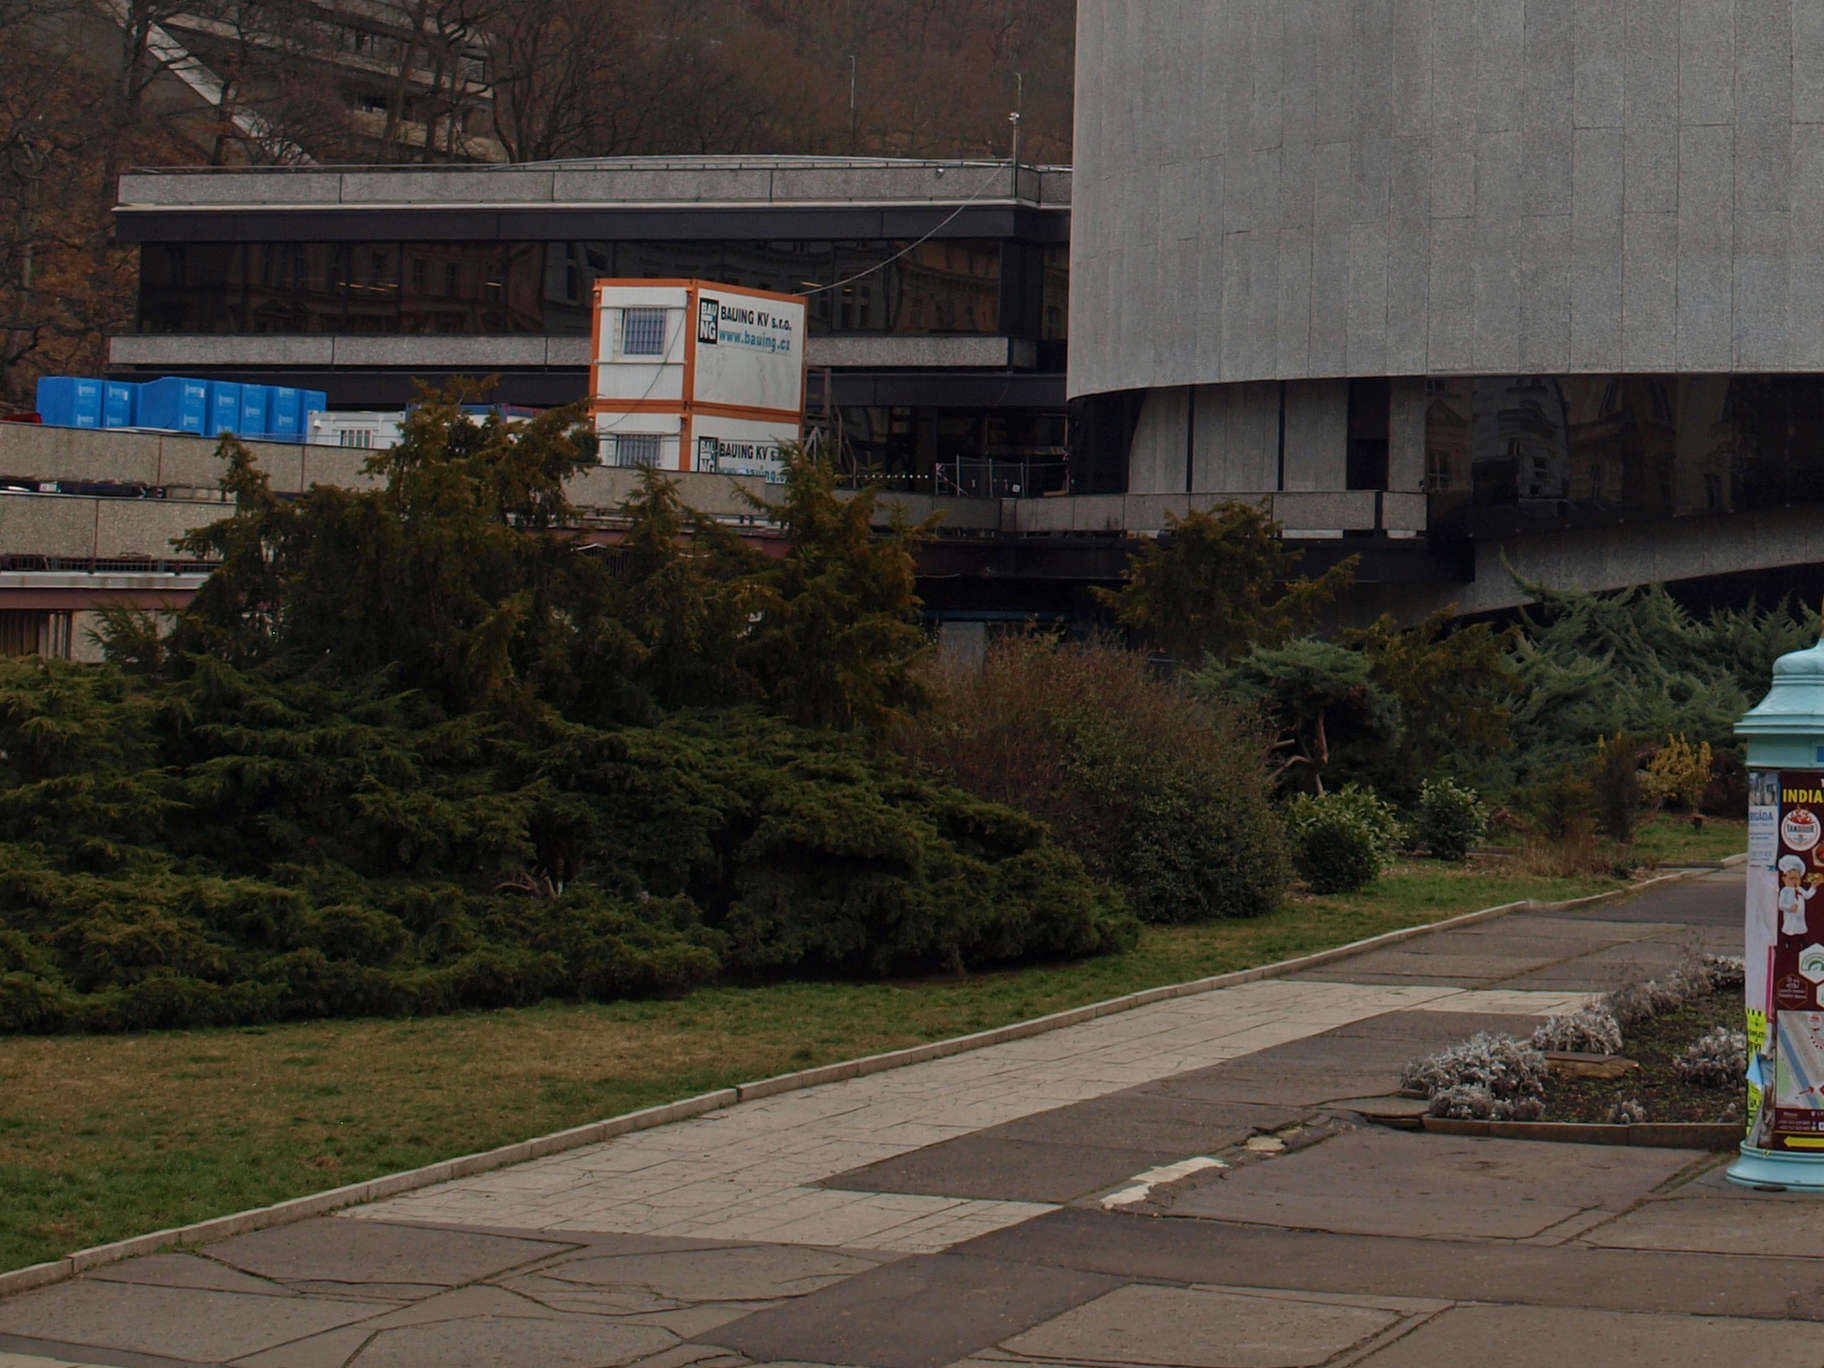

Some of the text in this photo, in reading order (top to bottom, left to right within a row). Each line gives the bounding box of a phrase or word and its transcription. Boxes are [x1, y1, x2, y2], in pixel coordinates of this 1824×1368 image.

[701, 302, 717, 316] BAU
[720, 306, 792, 331] BAUING KV s.r.o.
[699, 320, 717, 340] NG
[719, 330, 791, 353] www.bauing.cz
[719, 443, 754, 460] BAUING
[755, 445, 769, 461] KV
